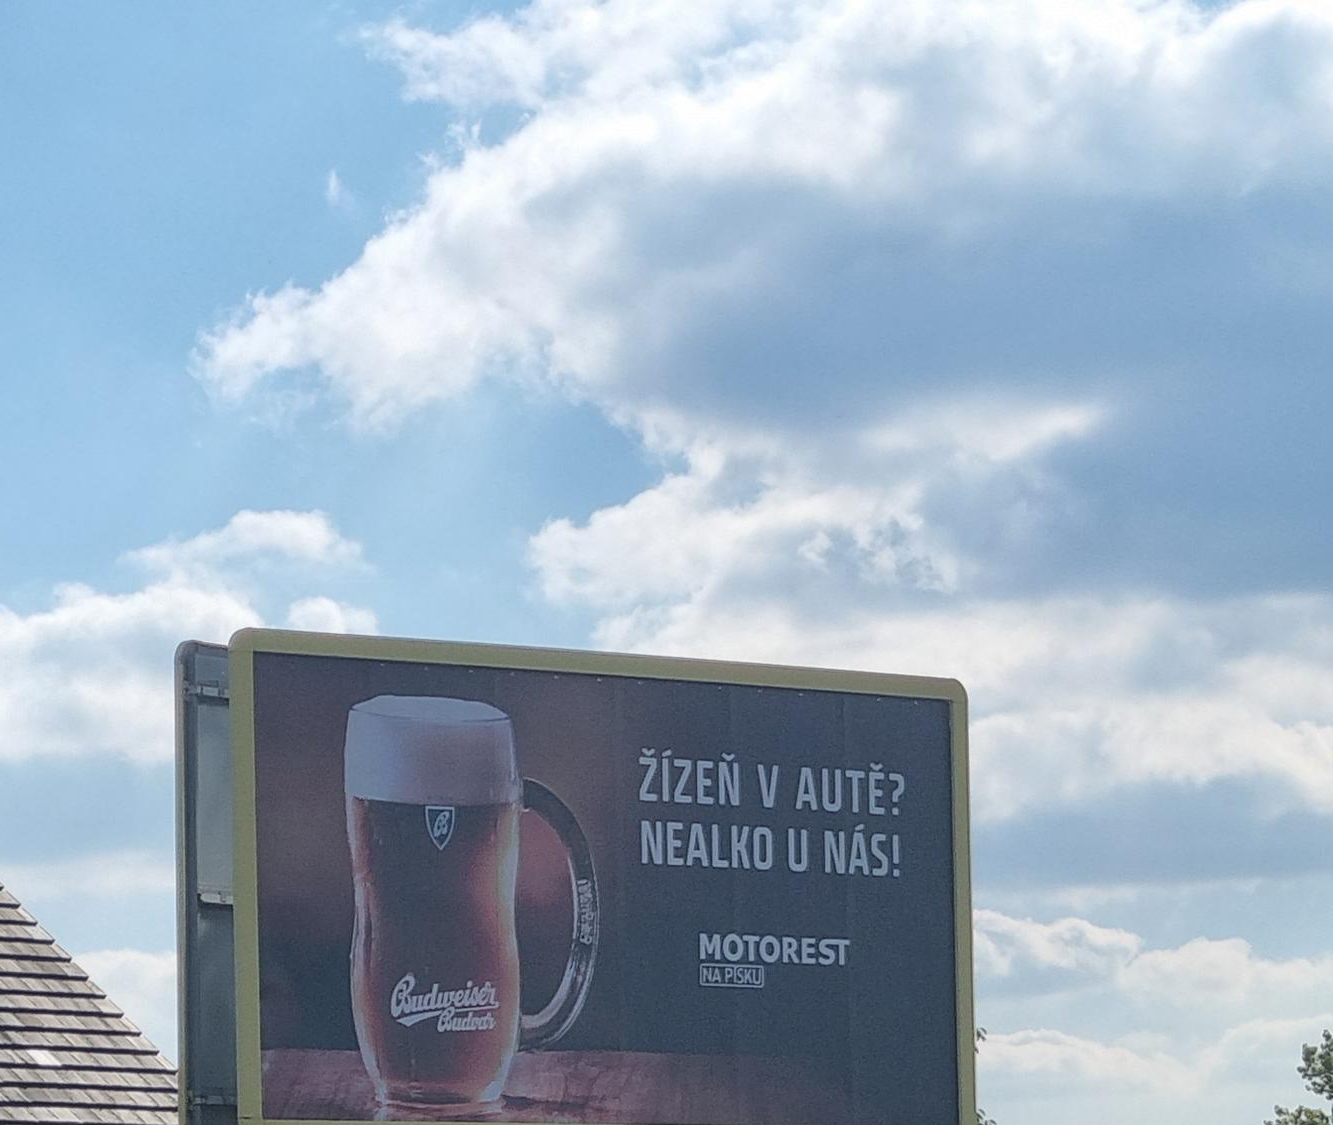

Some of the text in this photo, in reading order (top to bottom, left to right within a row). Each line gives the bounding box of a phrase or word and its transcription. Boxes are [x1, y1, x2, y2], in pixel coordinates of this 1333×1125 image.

[639, 747, 905, 816] ŽÍZEŇ V AUTĚ?
[641, 820, 900, 877] NEALKO U NÁS!
[699, 933, 850, 966] MOTOREST
[702, 967, 722, 983] NA
[391, 972, 499, 1019] Budweiser
[437, 1007, 496, 1032] Budvar
